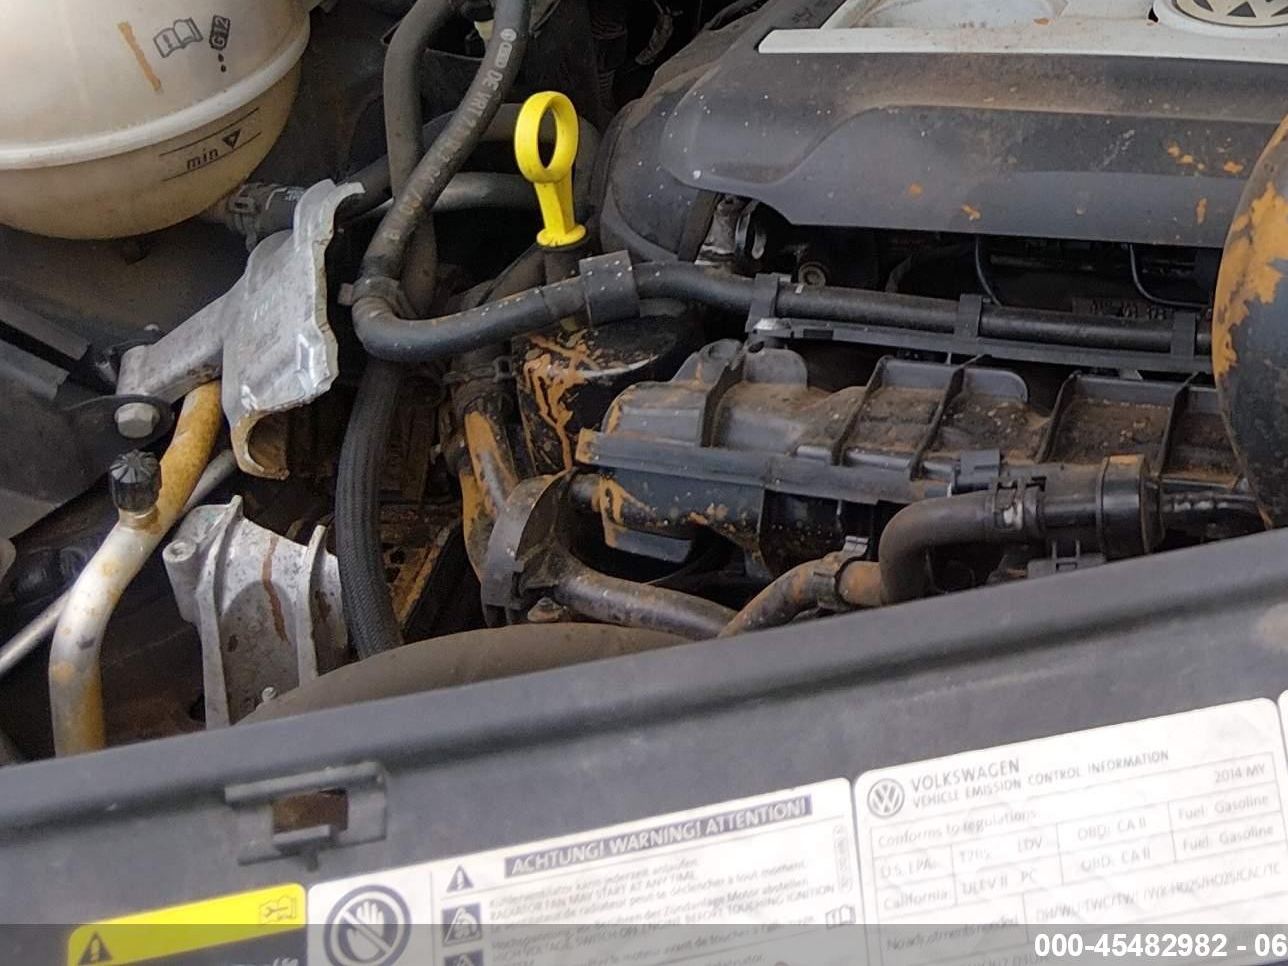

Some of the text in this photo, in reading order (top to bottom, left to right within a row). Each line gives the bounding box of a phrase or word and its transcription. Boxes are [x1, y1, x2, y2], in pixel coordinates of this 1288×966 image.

[210, 14, 230, 50] G12
[186, 147, 219, 171] min
[911, 759, 1020, 793] VOLKSWAGEN
[913, 750, 1169, 809] VEHICLE EMISSION CONTROL INFORMATION
[1214, 764, 1265, 783] 2014 MY
[1178, 794, 1270, 820] Fuel: Gasoline
[511, 797, 807, 875] ACHTUNG! WARNING! ATTENTION!
[878, 826, 943, 849] Conforms
[946, 822, 961, 836] to
[1117, 818, 1135, 833] CA
[1219, 824, 1274, 846] Gasoline
[1121, 849, 1140, 865] CA
